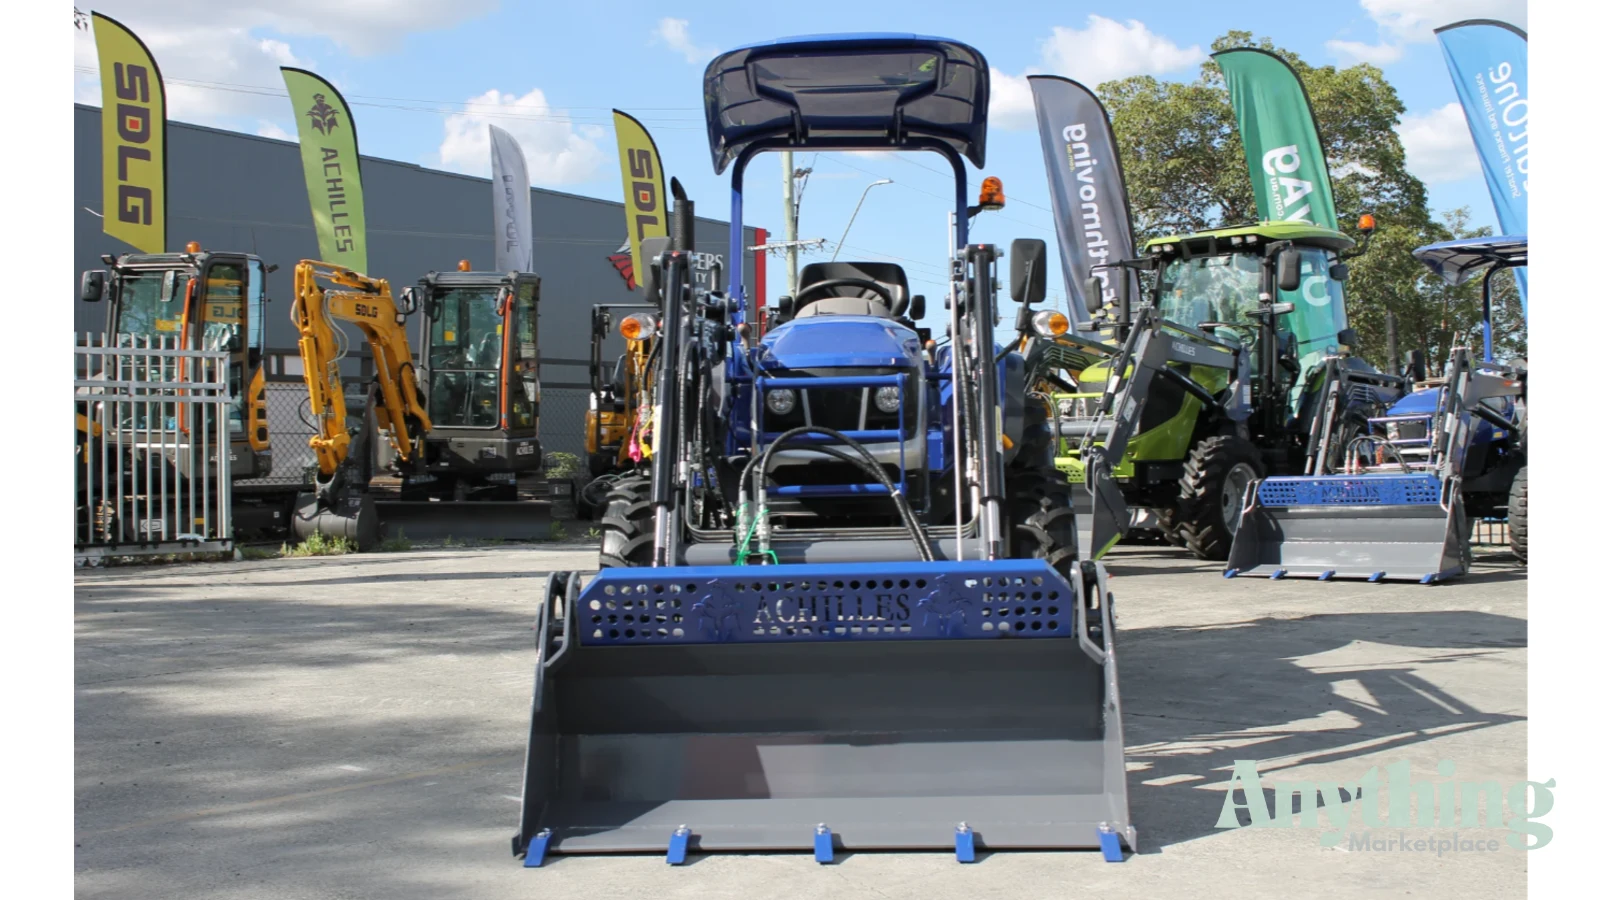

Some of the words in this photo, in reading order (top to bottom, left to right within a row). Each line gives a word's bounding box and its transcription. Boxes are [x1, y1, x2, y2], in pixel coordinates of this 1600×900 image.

[113, 61, 152, 226] SDLG
[320, 146, 355, 253] ACHILLES
[627, 148, 659, 242] SDL
[355, 303, 378, 318] SDLG
[752, 594, 911, 623] ACHILLES
